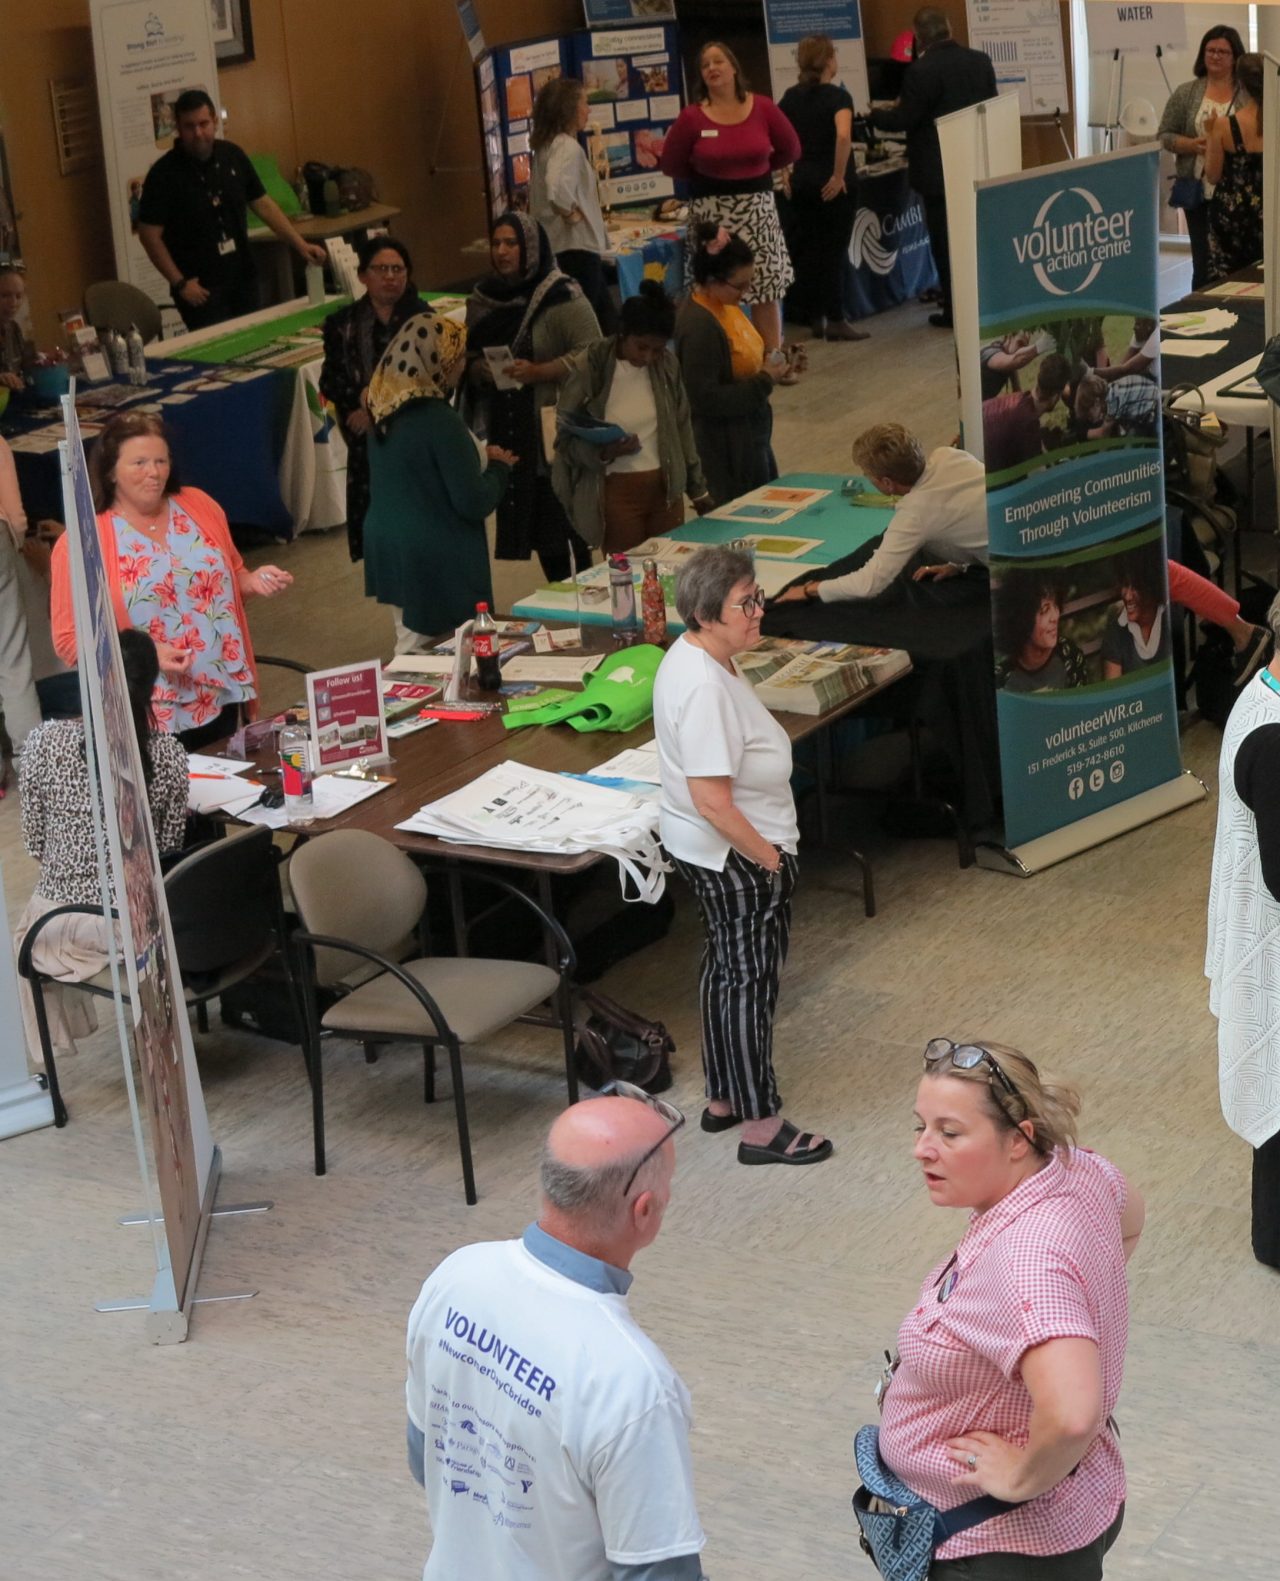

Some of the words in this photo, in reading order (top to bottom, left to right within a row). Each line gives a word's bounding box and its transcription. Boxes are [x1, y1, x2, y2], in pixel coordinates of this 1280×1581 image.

[1117, 6, 1153, 21] WATER
[1012, 209, 1134, 264] volunteer
[1046, 250, 1087, 273] action
[1091, 239, 1131, 262] centre
[1004, 487, 1082, 524] Empowering
[1084, 460, 1161, 496] Communities
[1019, 515, 1069, 545] Through
[1072, 490, 1151, 526] Volunteerism
[326, 676, 350, 688] Follow
[351, 673, 363, 682] us!
[1027, 764, 1040, 775] 151
[1042, 746, 1076, 769] Frederick
[1088, 735, 1107, 749] Suite
[1127, 713, 1163, 734] Kitchener
[1045, 699, 1143, 749] volunteerWR.ca
[1066, 743, 1125, 776] 519-742-8610
[444, 1306, 556, 1402] VOLUNTEER
